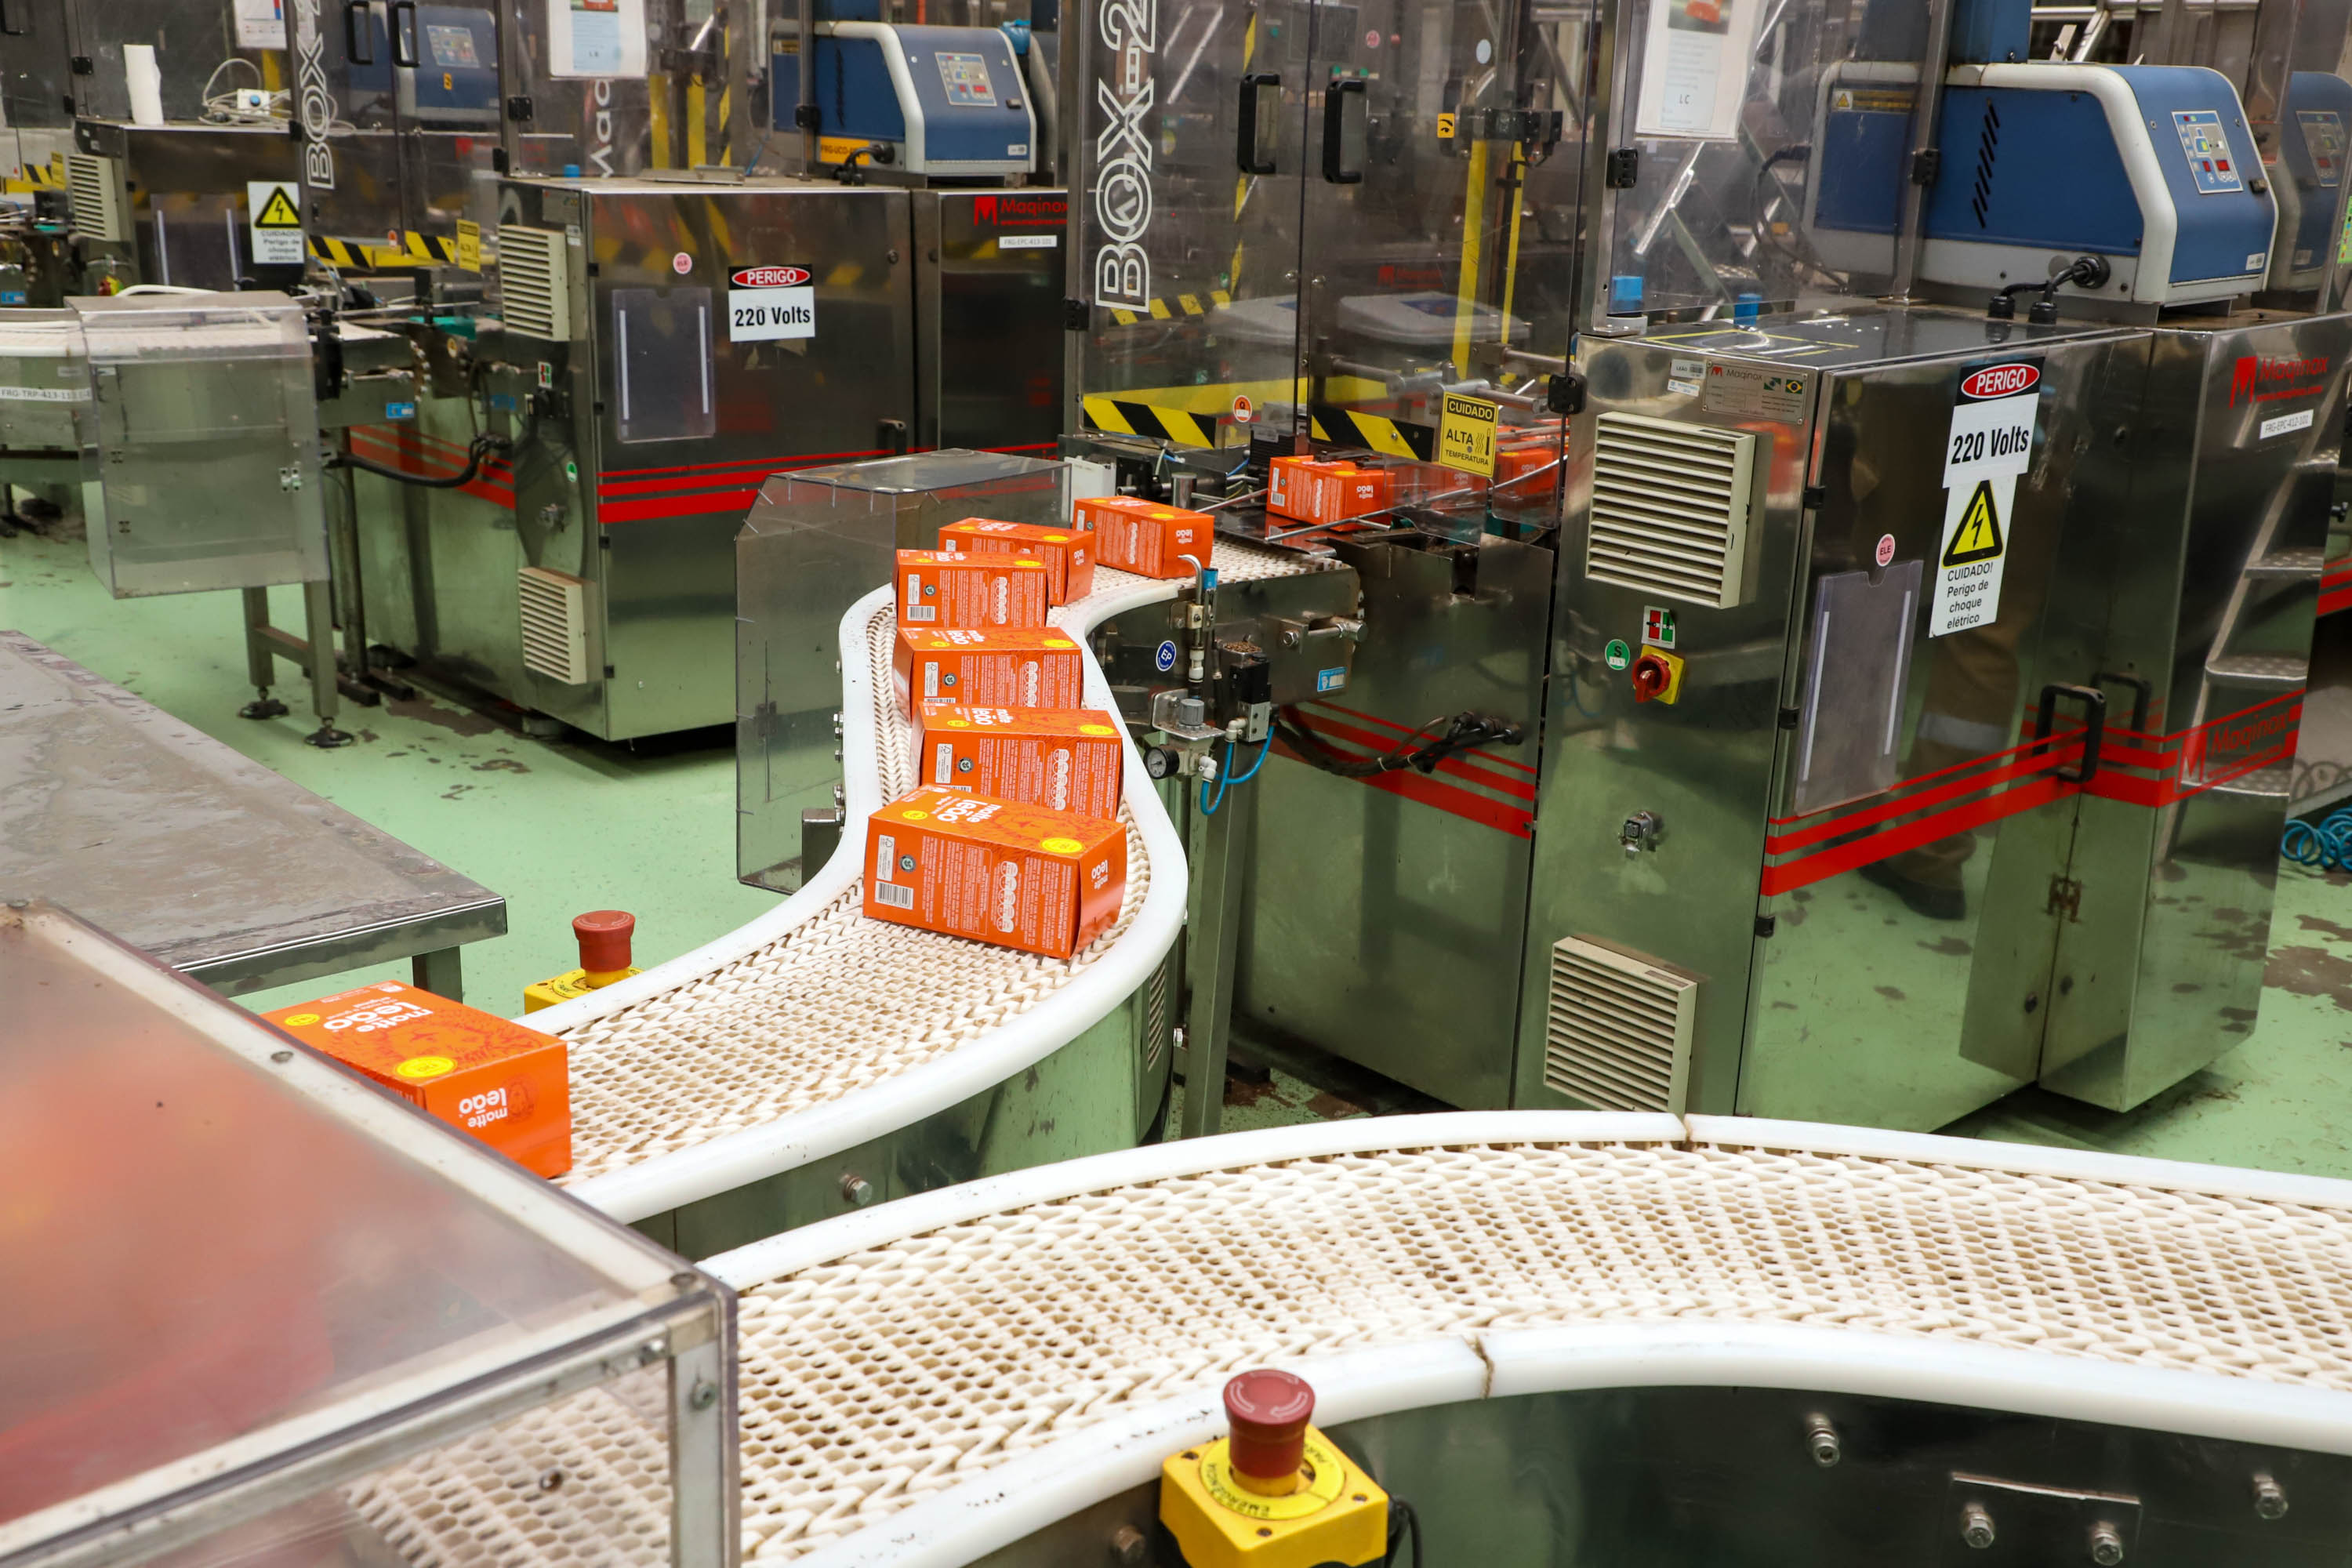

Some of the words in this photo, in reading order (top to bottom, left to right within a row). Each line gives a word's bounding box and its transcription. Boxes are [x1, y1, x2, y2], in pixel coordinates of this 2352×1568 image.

[747, 270, 797, 284] PERIGO
[735, 309, 765, 327] 220
[771, 306, 811, 325] Volts
[1976, 367, 2027, 394] PERIGO
[1449, 401, 1493, 420] CUIDADO
[1446, 428, 1473, 445] ALTA
[1951, 432, 1985, 464] 220
[1991, 426, 2029, 457] Volts
[1446, 449, 1489, 466] TEMPERATURA
[1879, 545, 1892, 556] ELE
[1947, 562, 1993, 582] CUIDADO!
[1947, 583, 1976, 598] Perigo
[1977, 579, 1989, 591] de
[1949, 597, 1982, 613] choque
[1947, 614, 1980, 630] elétrico
[1160, 648, 1172, 662] EP
[1613, 645, 1622, 658] S
[322, 1001, 422, 1030] leão
[355, 1008, 434, 1033] matte
[459, 1087, 507, 1115] leão
[467, 1108, 509, 1128] matte
